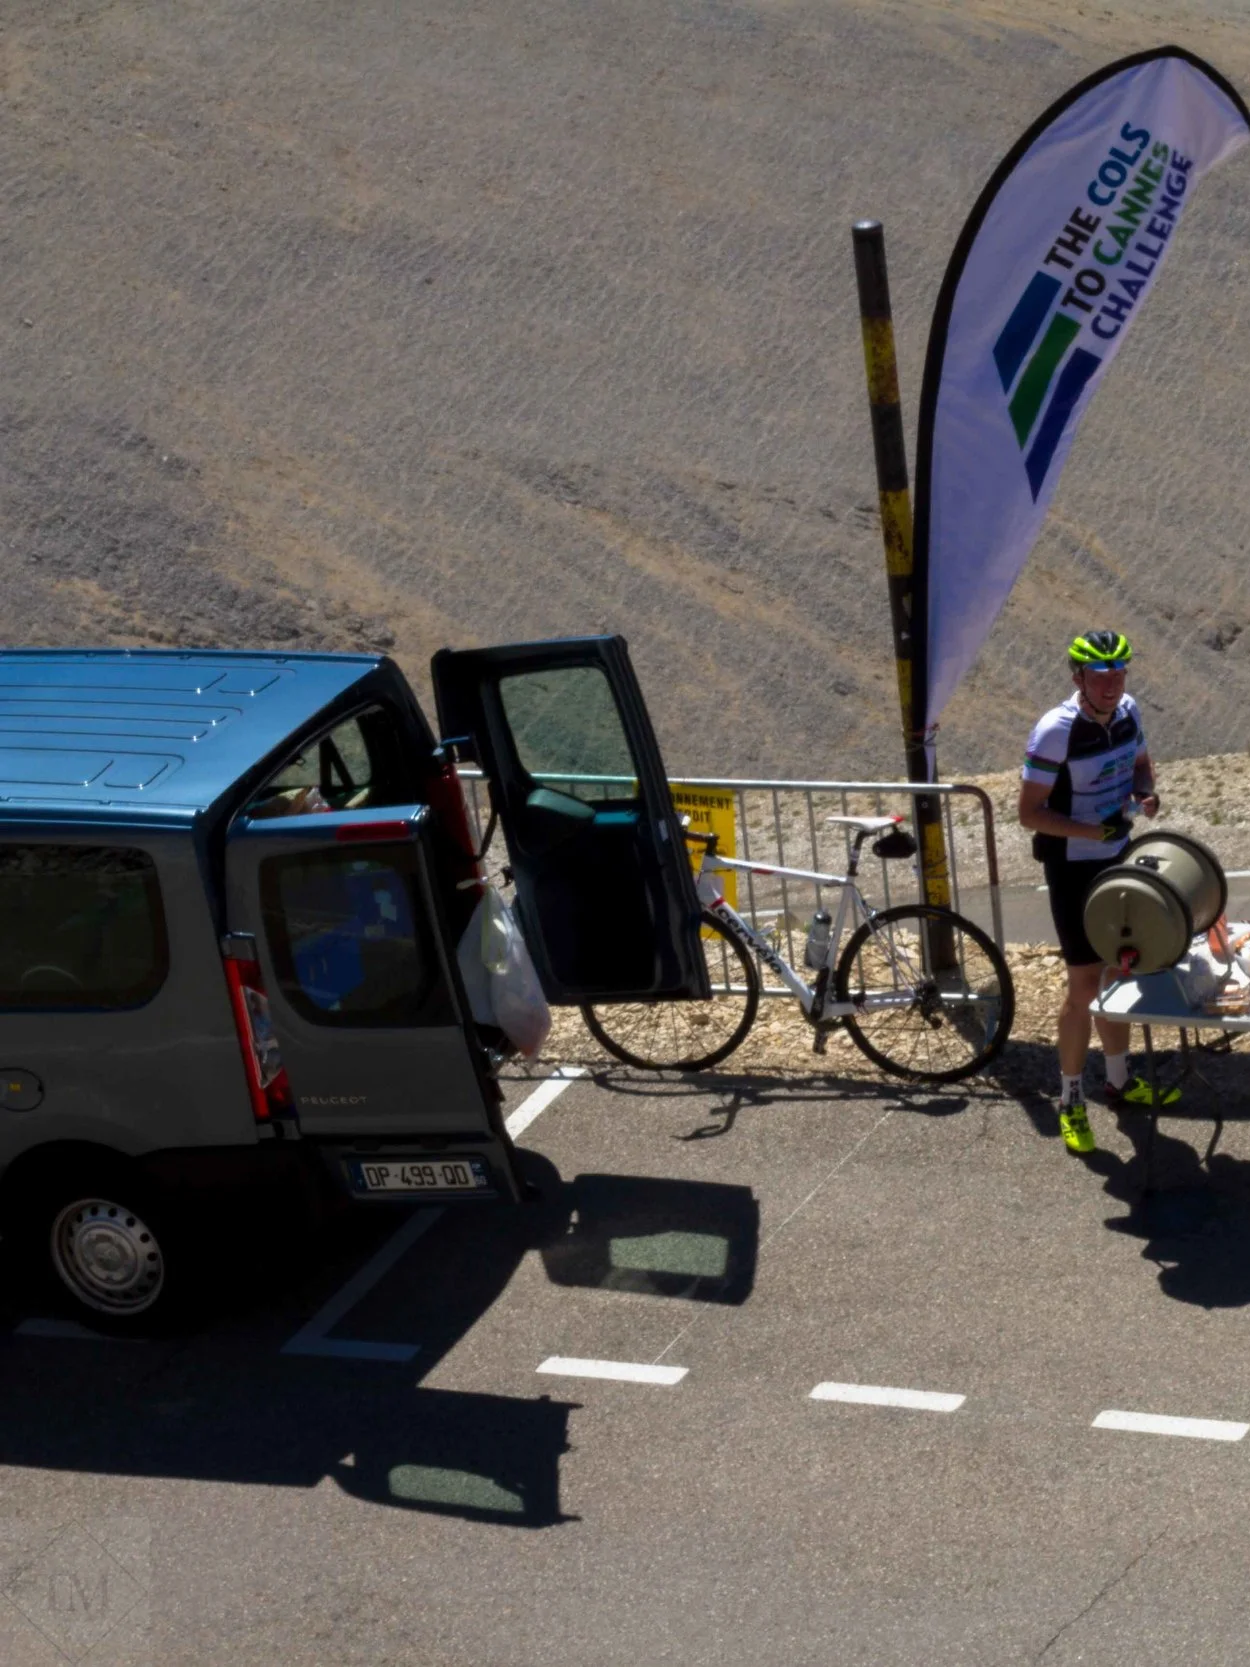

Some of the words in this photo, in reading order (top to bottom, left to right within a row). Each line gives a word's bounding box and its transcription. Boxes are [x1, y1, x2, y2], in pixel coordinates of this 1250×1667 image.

[1043, 206, 1102, 270] THE
[1087, 121, 1151, 206] COLS
[1061, 268, 1106, 313] TO
[1092, 140, 1170, 266] CANNES
[1091, 150, 1193, 340] CHALLENGE
[300, 1096, 367, 1105] PEUGEOT
